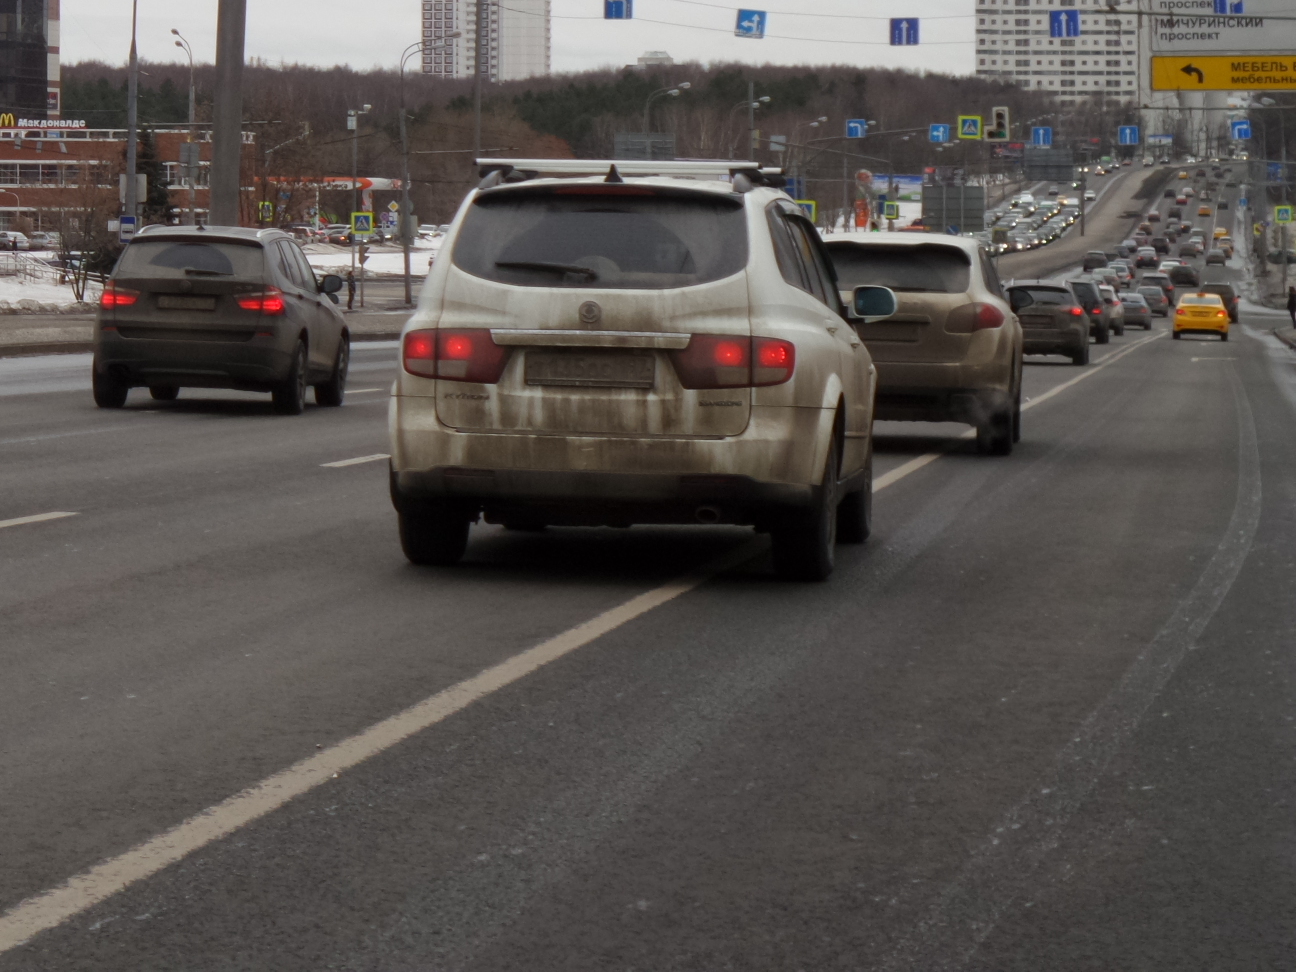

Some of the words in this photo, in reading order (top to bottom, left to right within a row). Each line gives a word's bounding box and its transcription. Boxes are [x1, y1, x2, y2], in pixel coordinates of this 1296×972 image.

[1160, 1, 1214, 11] проспек
[1160, 18, 1264, 28] МИЧУРИНСКИЙ
[1160, 31, 1220, 42] проспект
[1231, 62, 1288, 72] МЕБЕЛЬ
[18, 118, 86, 128] Макдоналдс
